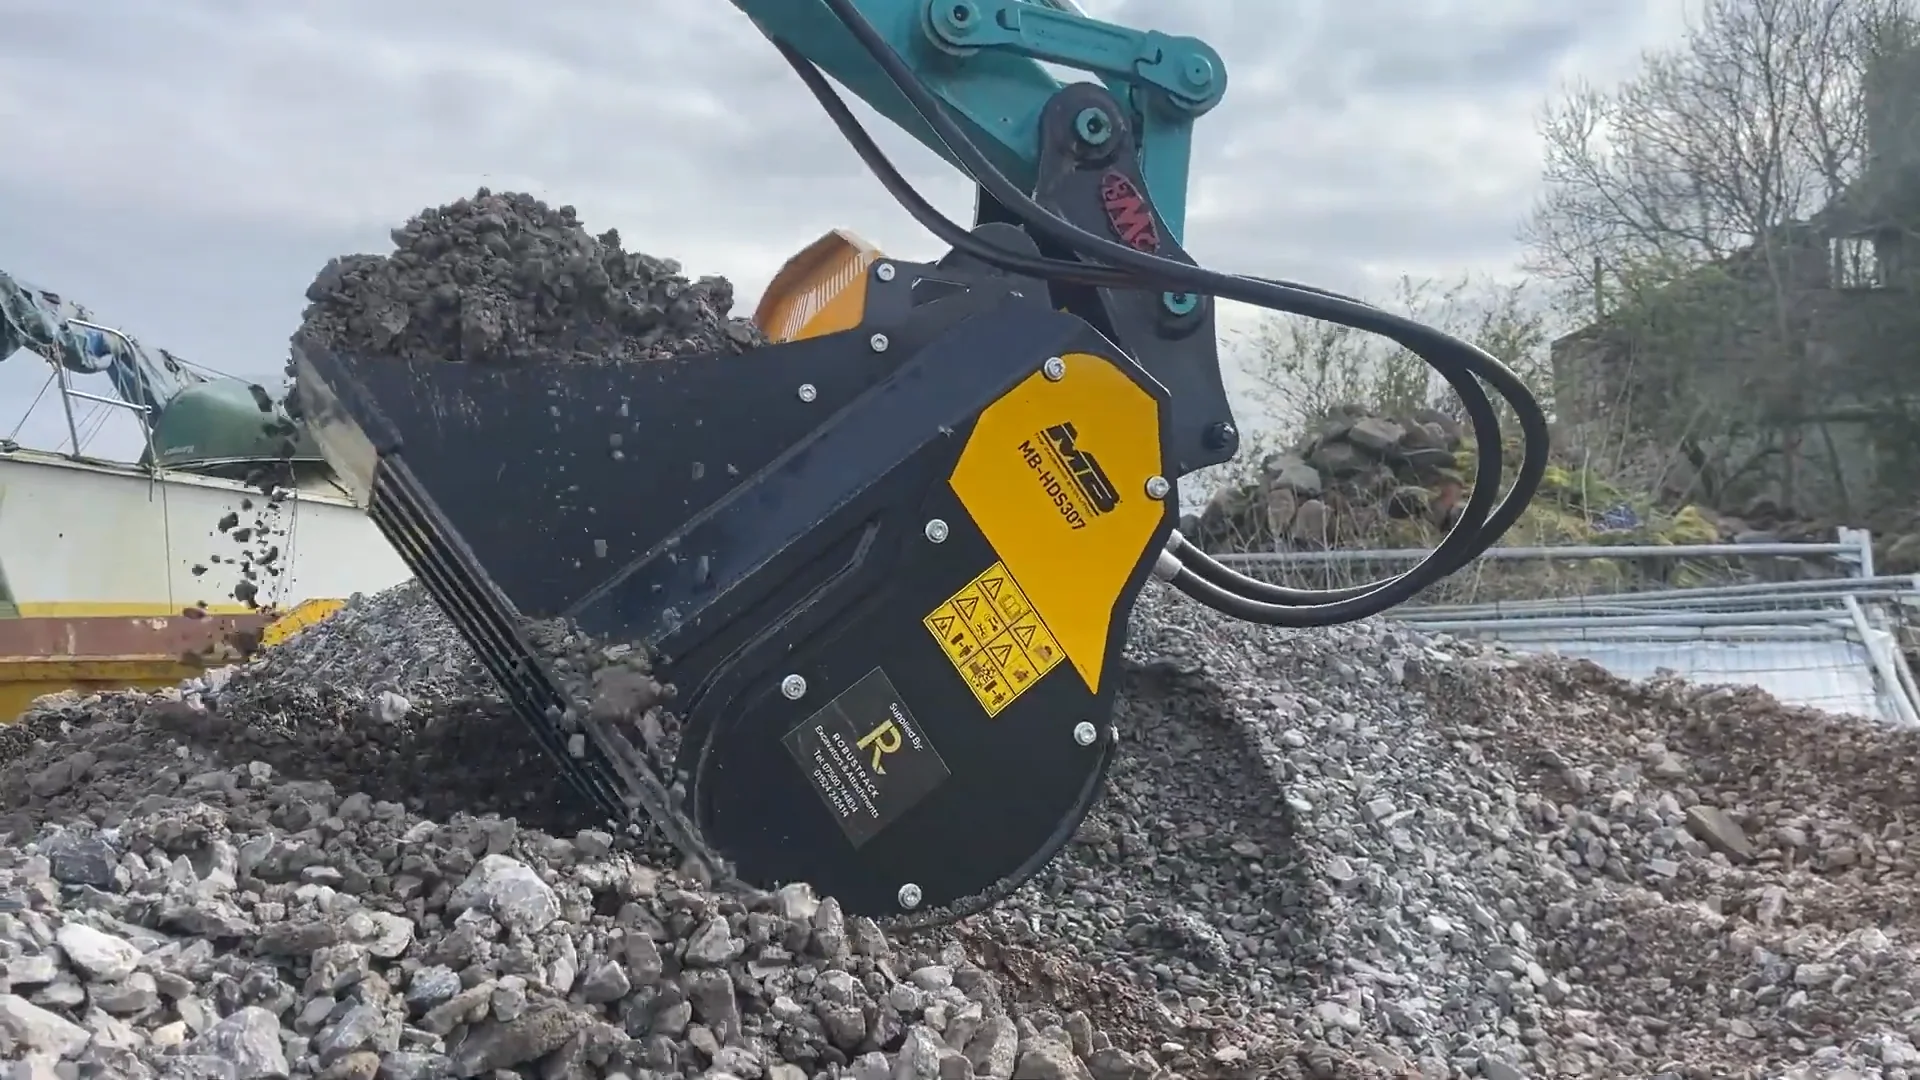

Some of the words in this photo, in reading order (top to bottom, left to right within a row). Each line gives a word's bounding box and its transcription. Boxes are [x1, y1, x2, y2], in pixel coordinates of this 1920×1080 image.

[1017, 440, 1087, 530] MB-HDS307
[1046, 421, 1120, 513] MB
[889, 702, 916, 739] Supplied
[813, 769, 833, 792] 01524
[814, 725, 844, 767] Excavators
[840, 764, 849, 773] &
[845, 771, 880, 819] Attachments
[821, 762, 841, 787] 07500
[832, 733, 880, 799] ROBUSTRACK
